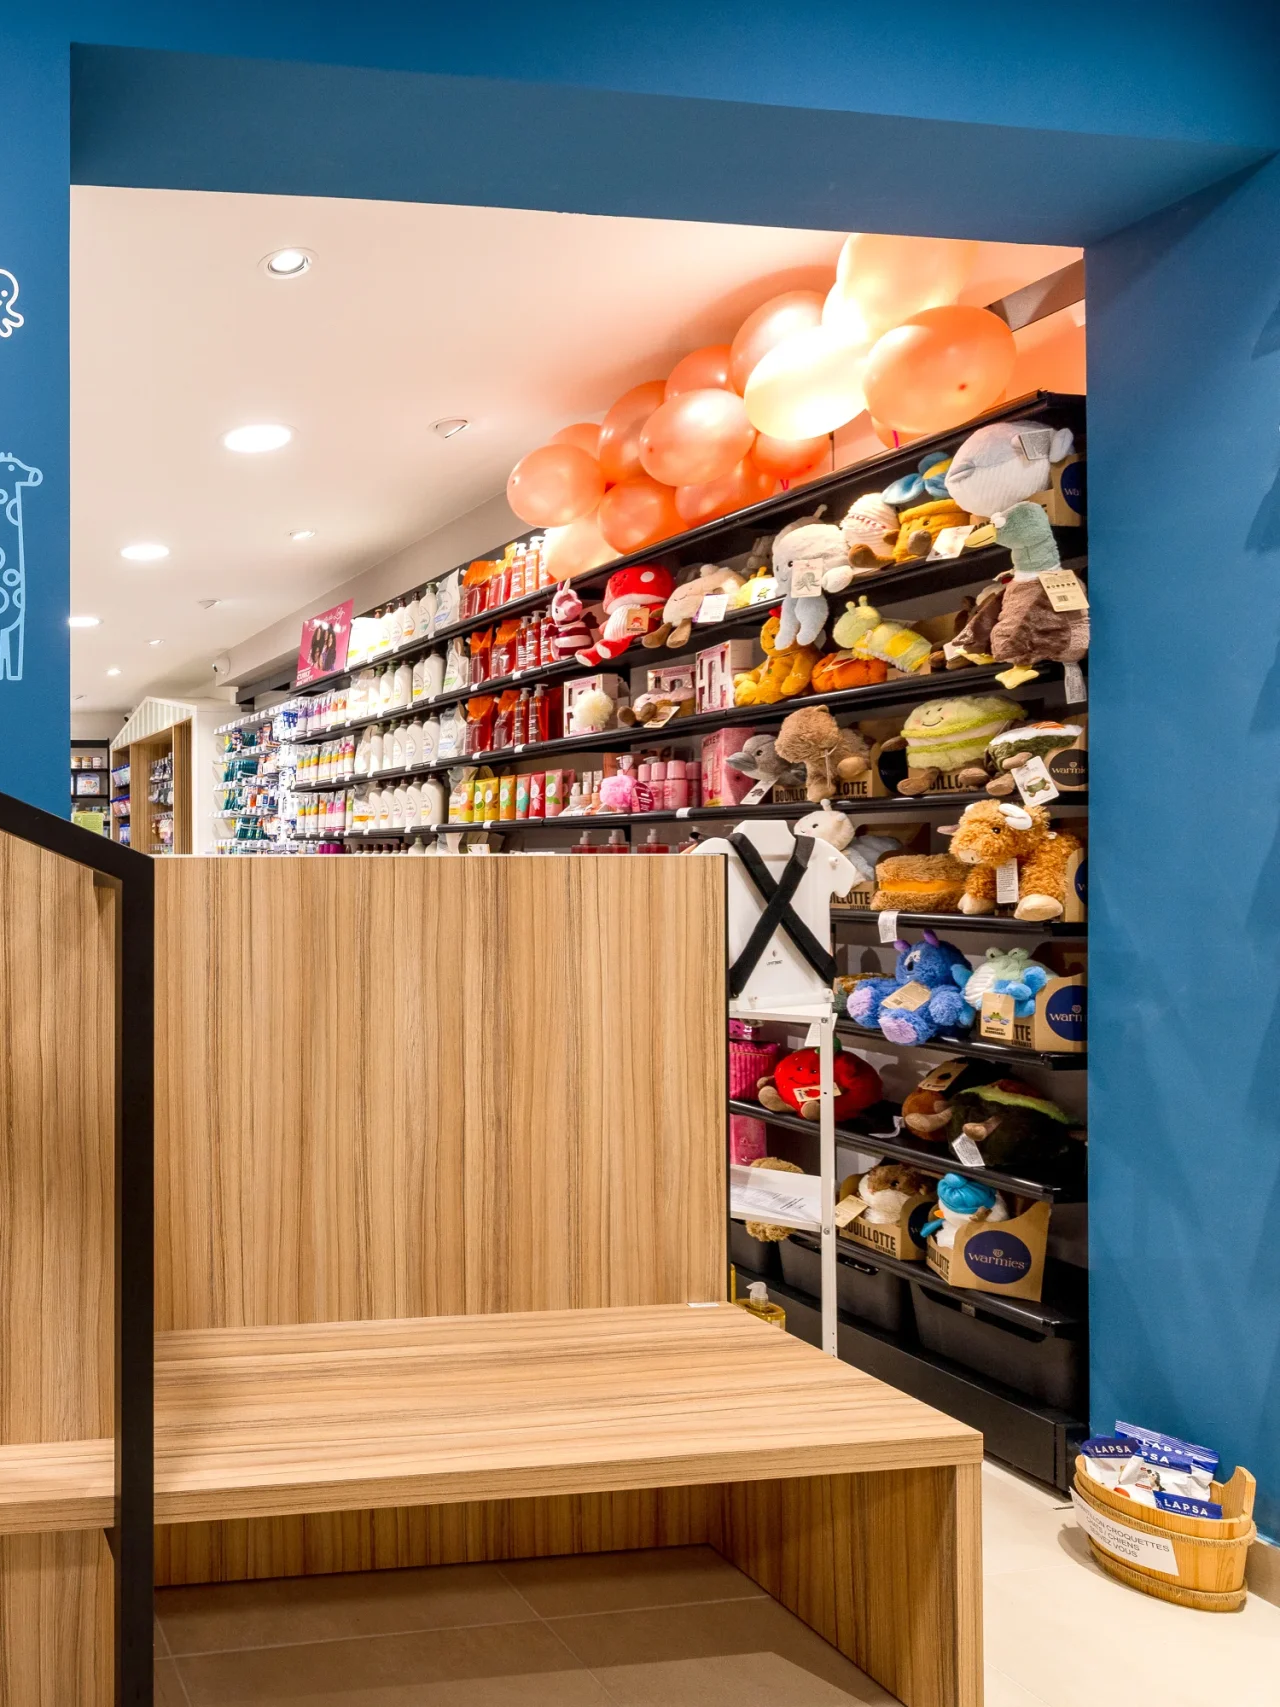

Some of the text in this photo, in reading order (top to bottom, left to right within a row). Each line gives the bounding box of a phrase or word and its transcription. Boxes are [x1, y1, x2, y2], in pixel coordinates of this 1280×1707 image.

[968, 1252, 1025, 1270] warmies
[1094, 1445, 1132, 1454] LAPSA
[1163, 1498, 1208, 1517] LAPSA
[1106, 1524, 1170, 1552] CROQUETTES
[1113, 1542, 1138, 1558] VOUS
